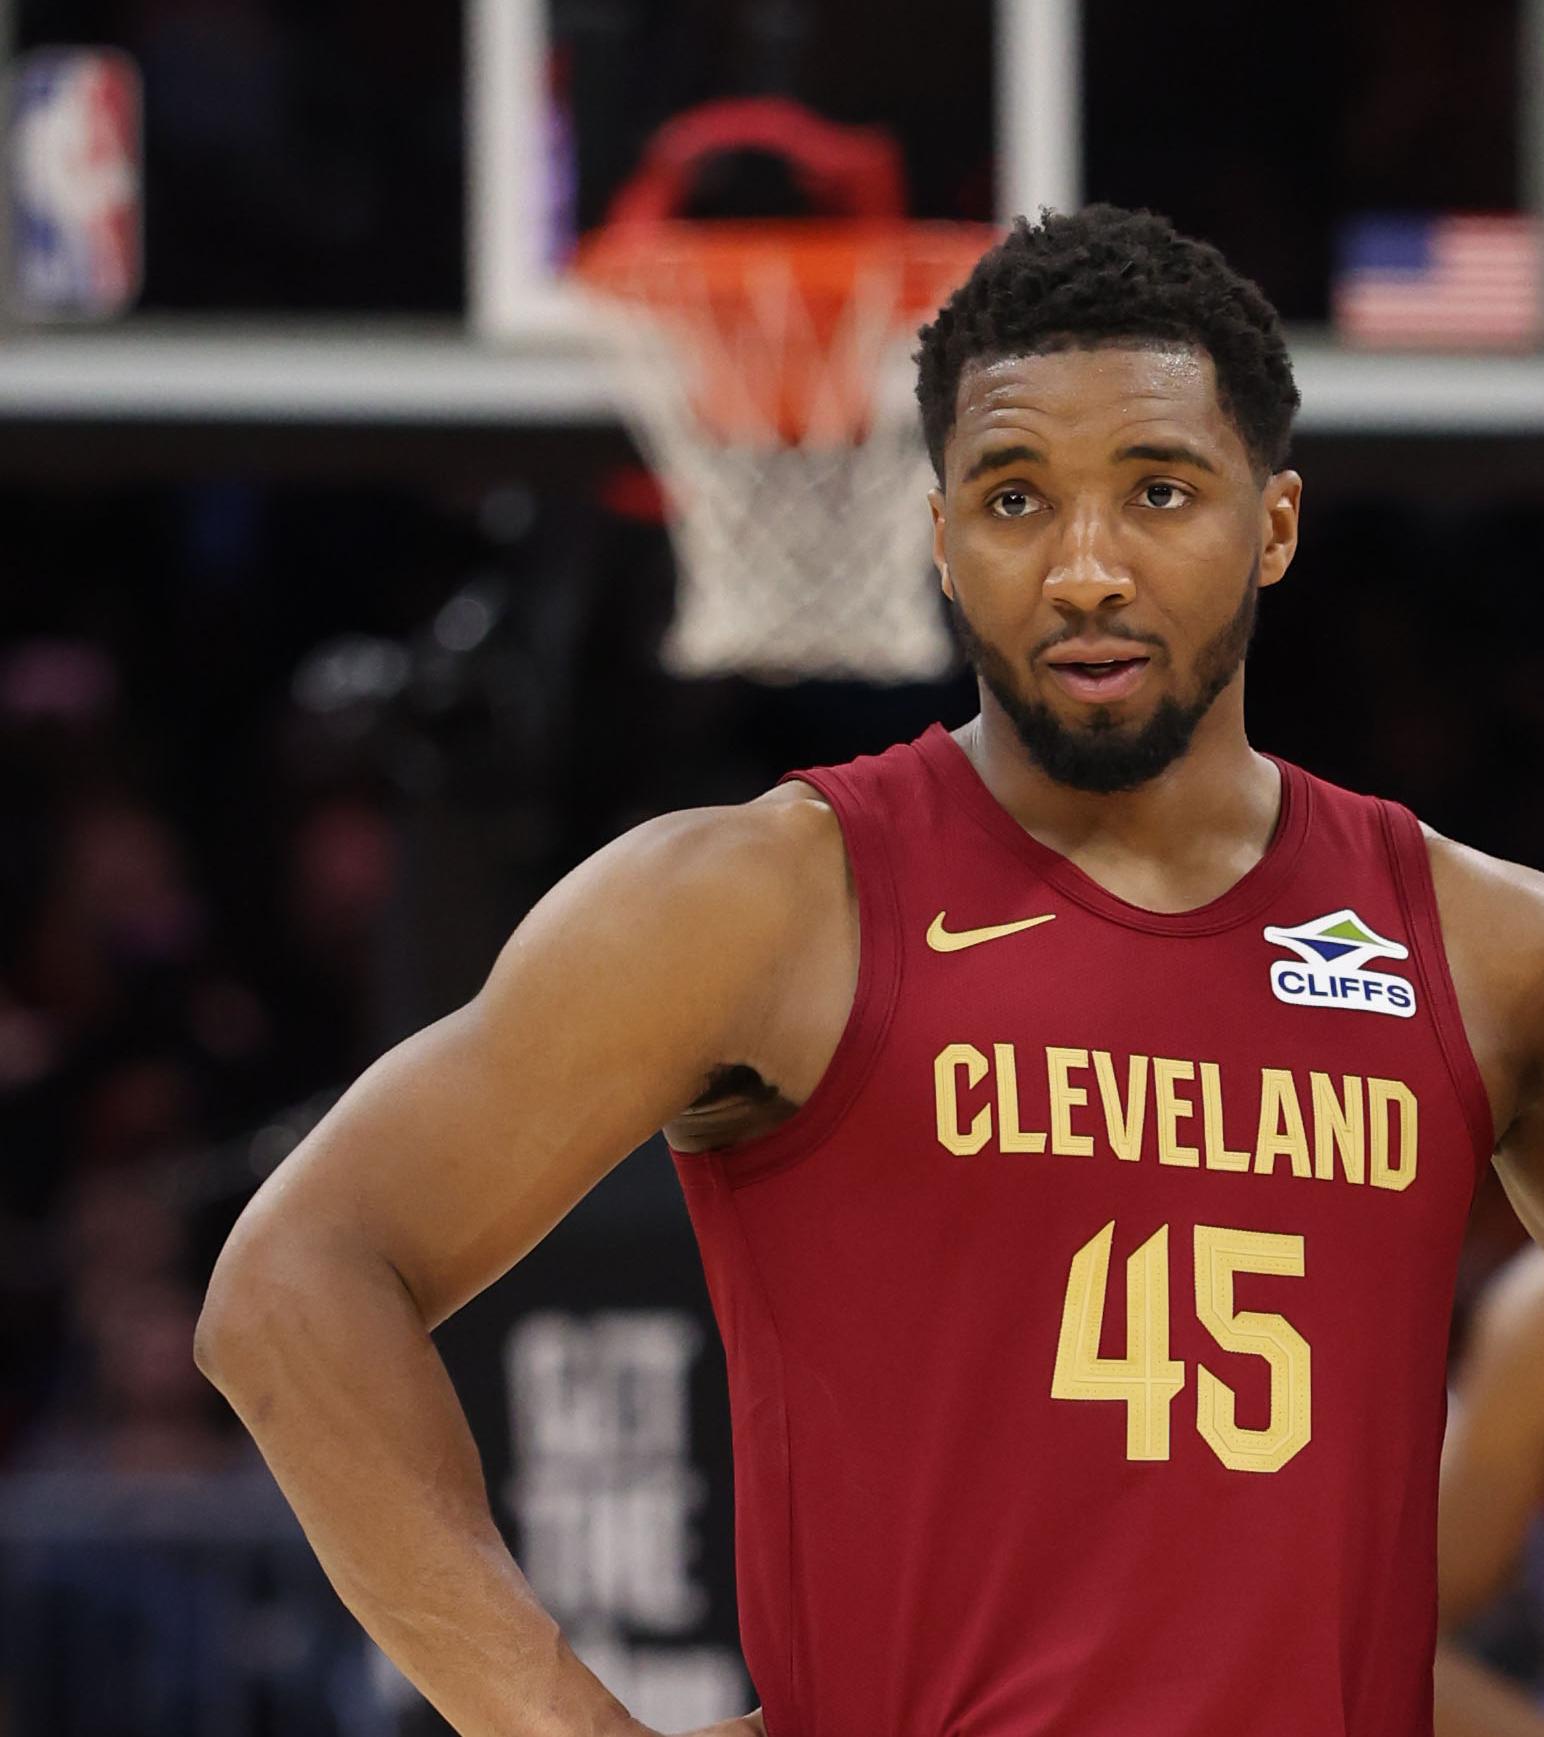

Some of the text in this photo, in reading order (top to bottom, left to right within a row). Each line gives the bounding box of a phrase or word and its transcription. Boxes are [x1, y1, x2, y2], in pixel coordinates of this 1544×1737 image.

[1277, 970, 1411, 1008] CLIFFS
[934, 1043, 1418, 1191] CLEVELAND
[1051, 1220, 1311, 1472] 45
